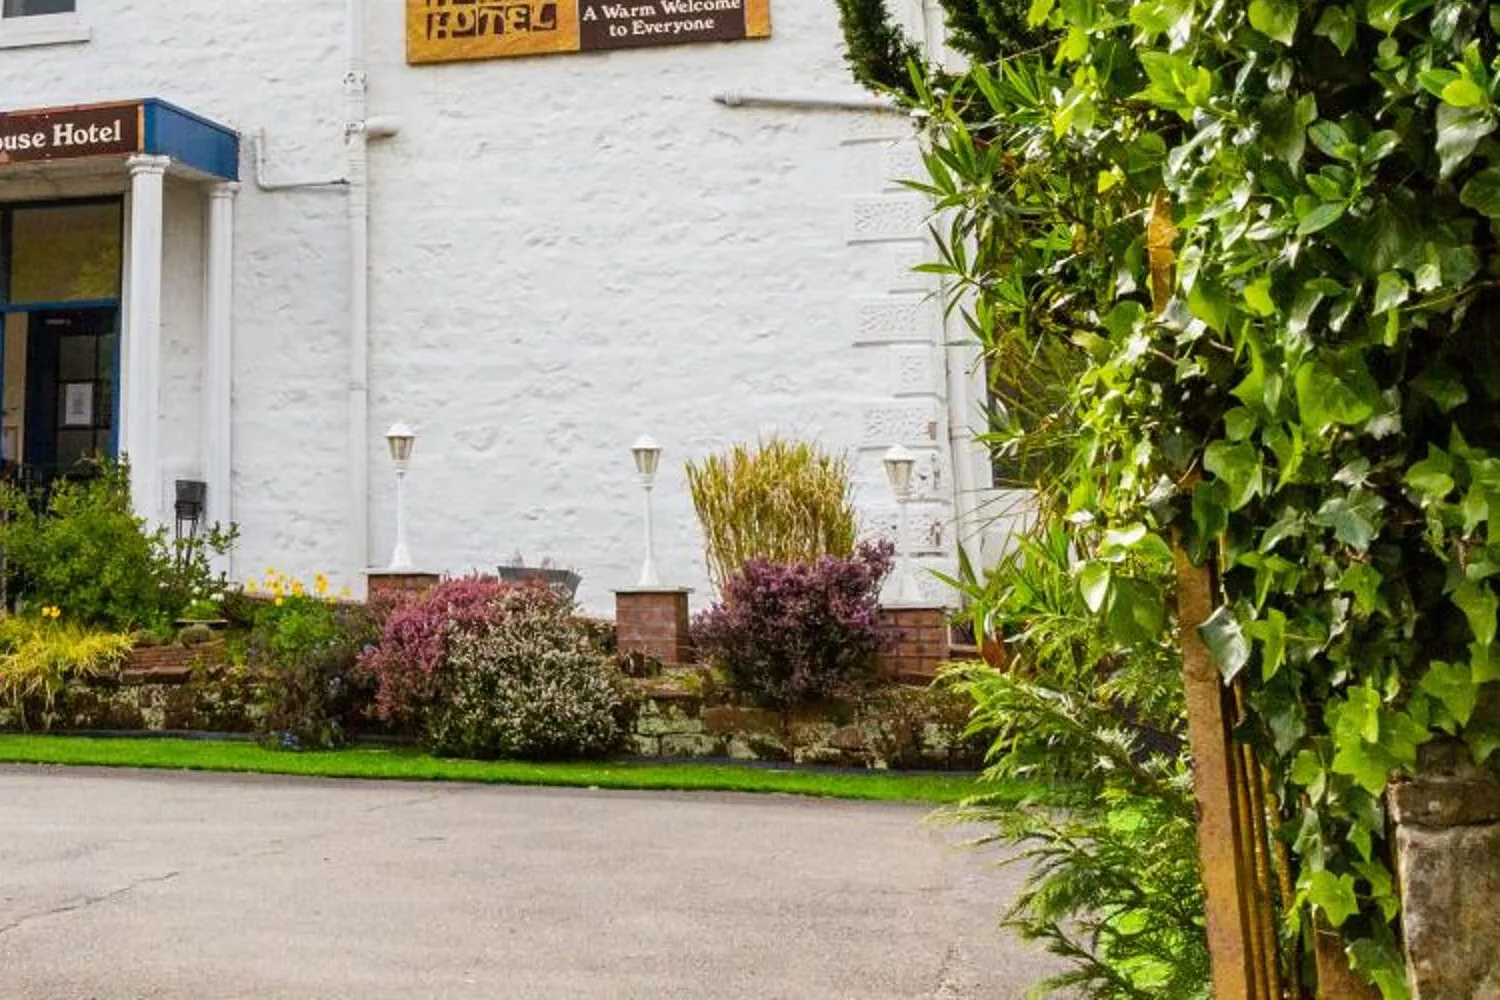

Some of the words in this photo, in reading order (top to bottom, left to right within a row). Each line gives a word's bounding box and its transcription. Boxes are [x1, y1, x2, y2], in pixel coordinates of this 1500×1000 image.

[426, 3, 556, 40] HOTEL
[582, 6, 598, 21] A
[602, 3, 656, 20] Warm
[609, 21, 627, 37] to
[632, 17, 715, 38] Everyone
[53, 119, 122, 146] Hotel
